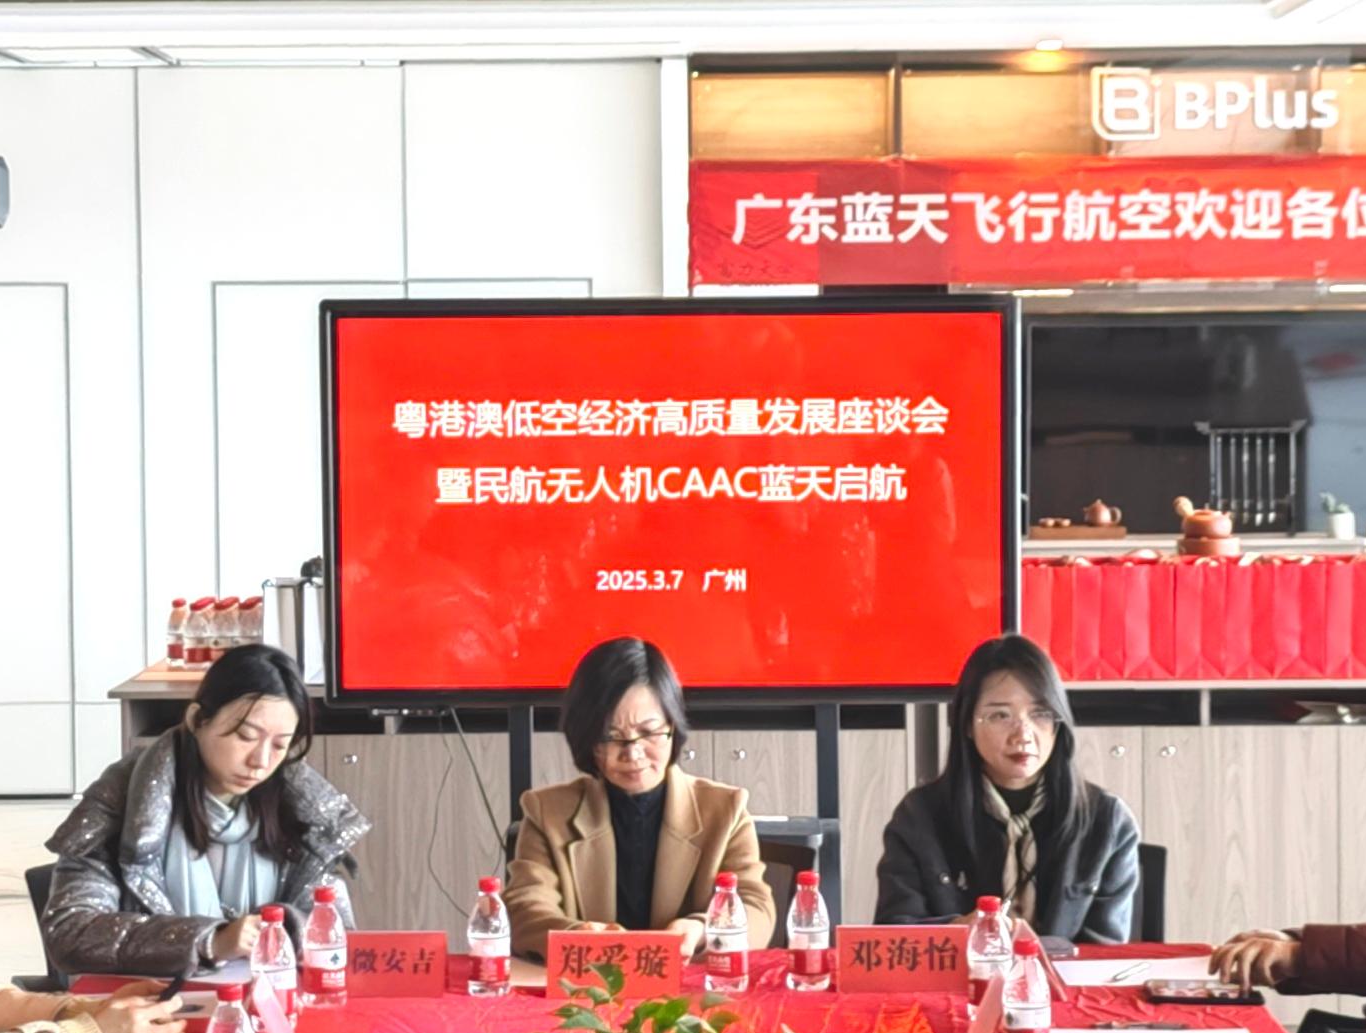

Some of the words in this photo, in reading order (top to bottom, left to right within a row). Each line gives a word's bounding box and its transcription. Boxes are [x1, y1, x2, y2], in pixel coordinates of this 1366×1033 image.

[1174, 76, 1339, 130] BPlus
[392, 396, 950, 438] 粤港澳低空经济高质量发展座谈会
[435, 464, 908, 505] 暨民航无人机CAAC蓝天启航
[595, 570, 685, 592] 2025.3.7
[701, 569, 747, 592] 广州
[849, 936, 958, 972] 邓海怡
